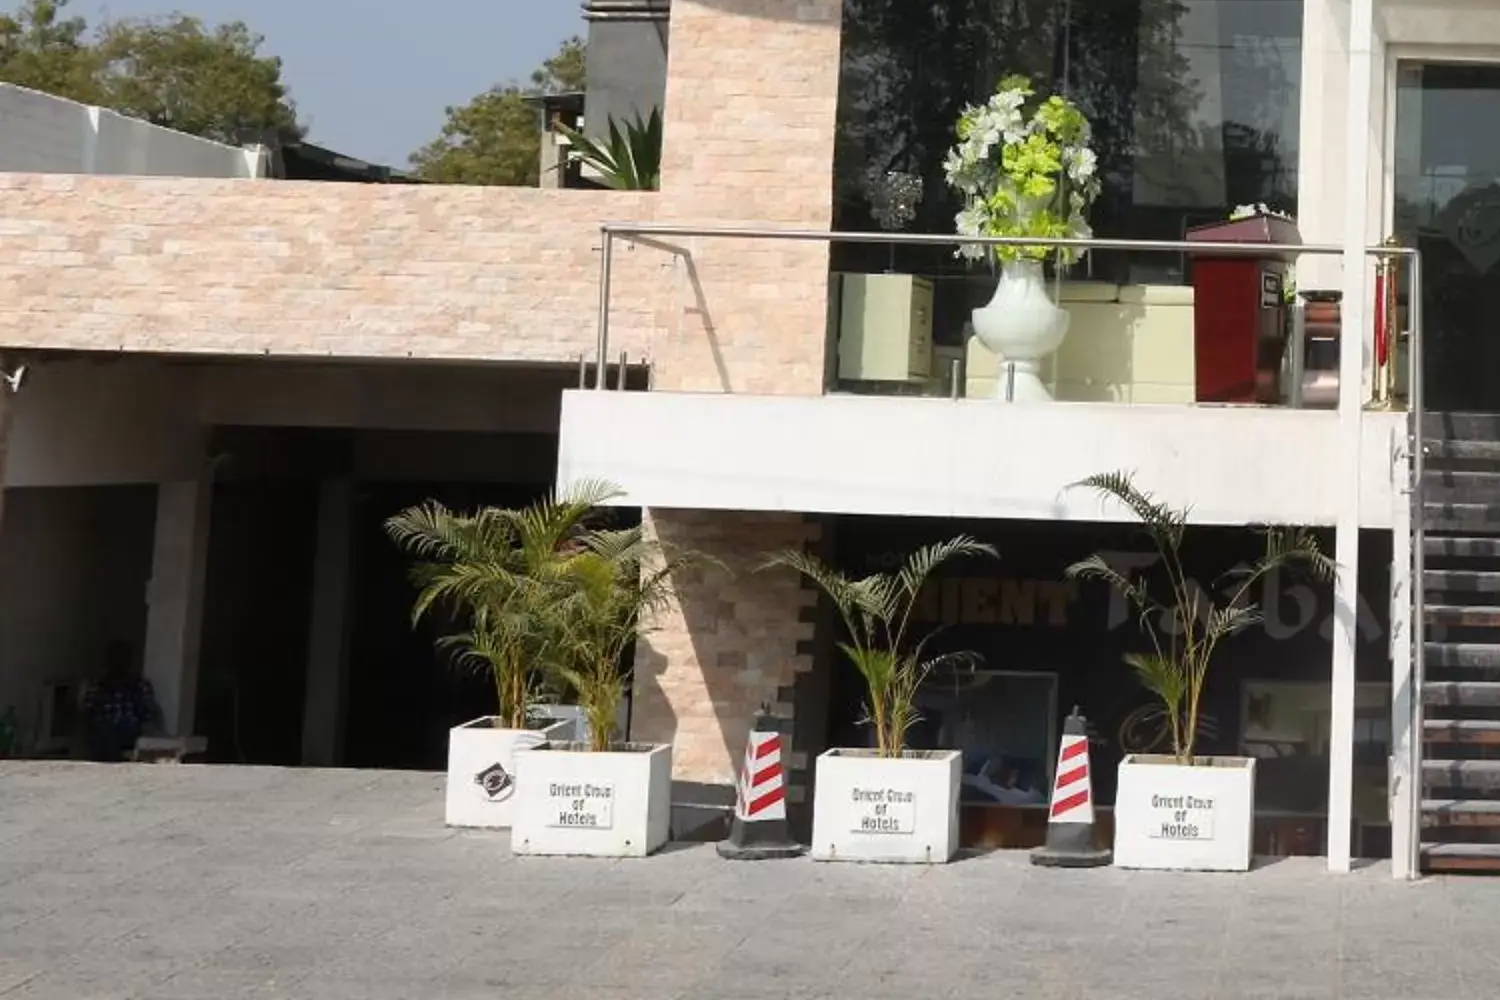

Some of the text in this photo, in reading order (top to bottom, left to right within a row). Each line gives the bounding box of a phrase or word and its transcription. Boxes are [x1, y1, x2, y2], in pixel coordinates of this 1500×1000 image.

[550, 784, 582, 797] Orient
[572, 799, 586, 811] of
[875, 803, 888, 815] of
[559, 812, 597, 825] Hotels
[1174, 809, 1188, 822] of
[861, 816, 900, 830] Hotels
[1161, 822, 1199, 837] Hotels
